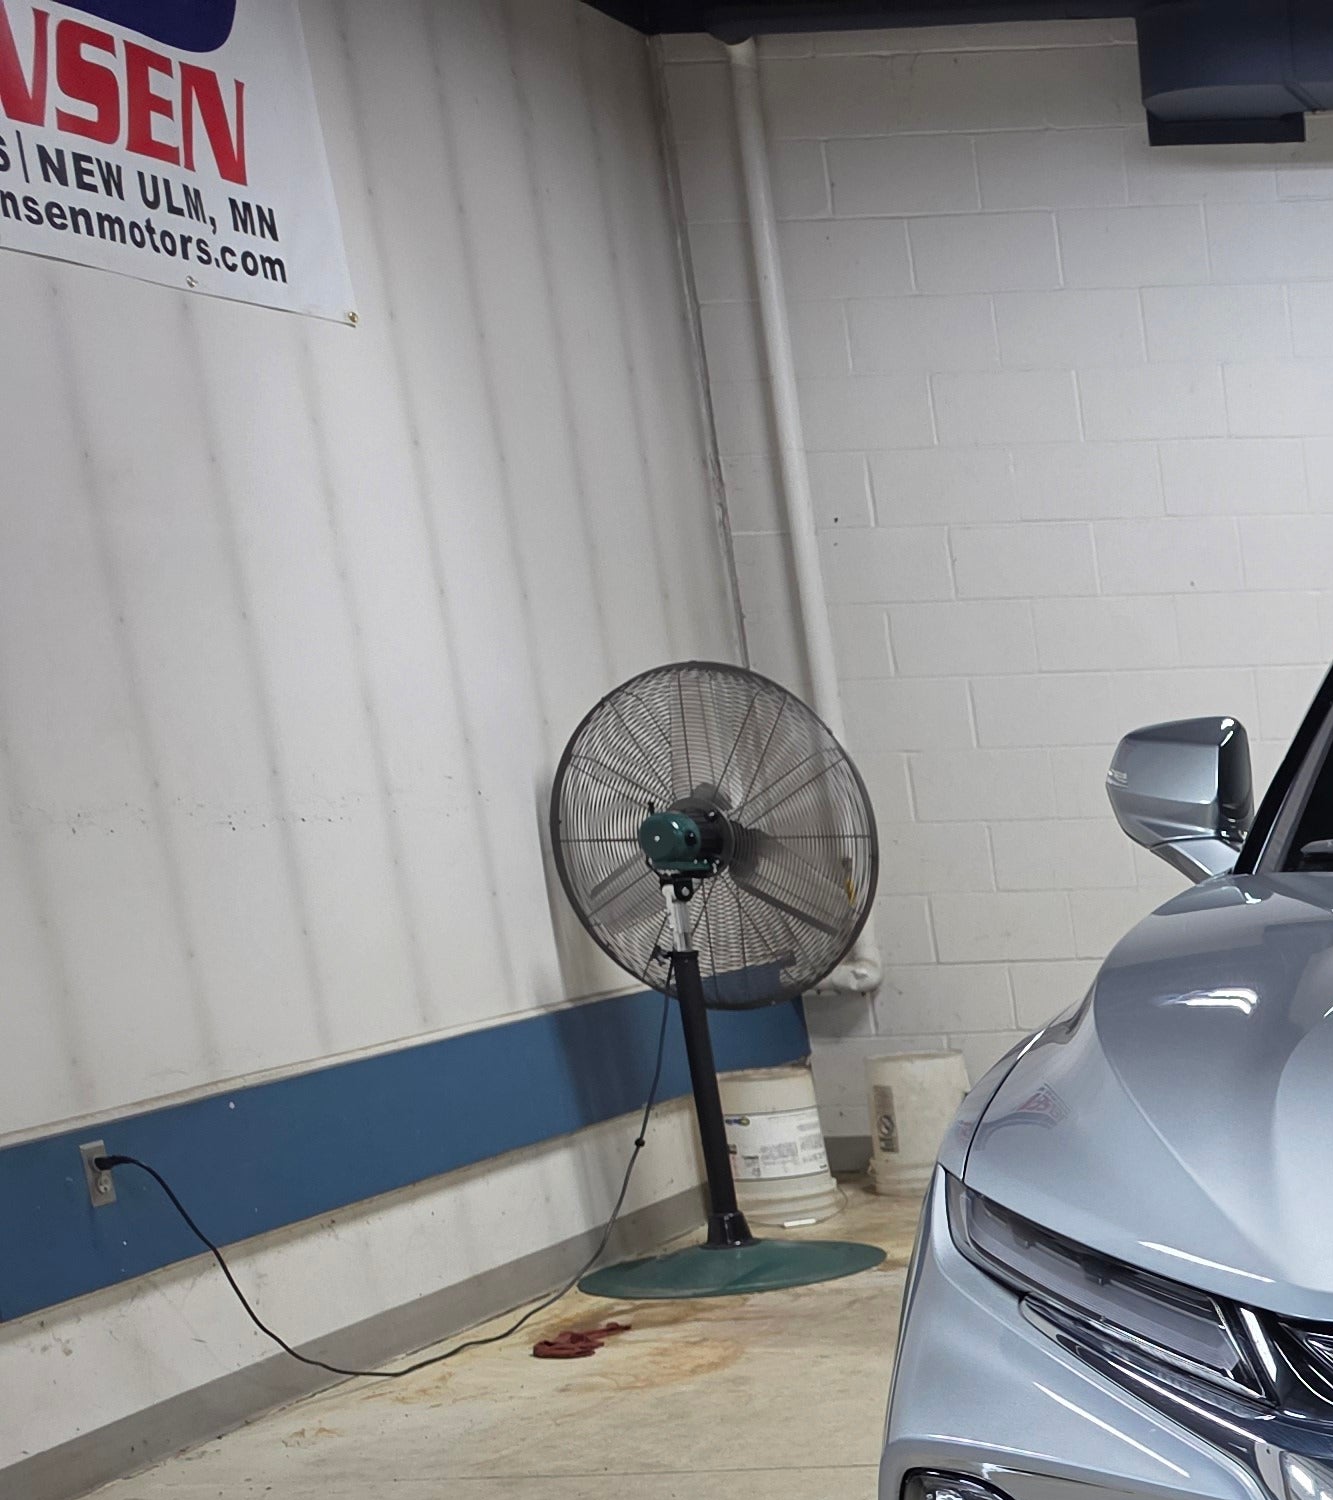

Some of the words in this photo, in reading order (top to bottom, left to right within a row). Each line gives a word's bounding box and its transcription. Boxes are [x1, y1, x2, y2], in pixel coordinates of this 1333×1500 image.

[0, 189, 288, 285] nsenmotors.com
[36, 144, 125, 201] NEW
[137, 170, 217, 235] ULM,
[228, 197, 280, 242] MN
